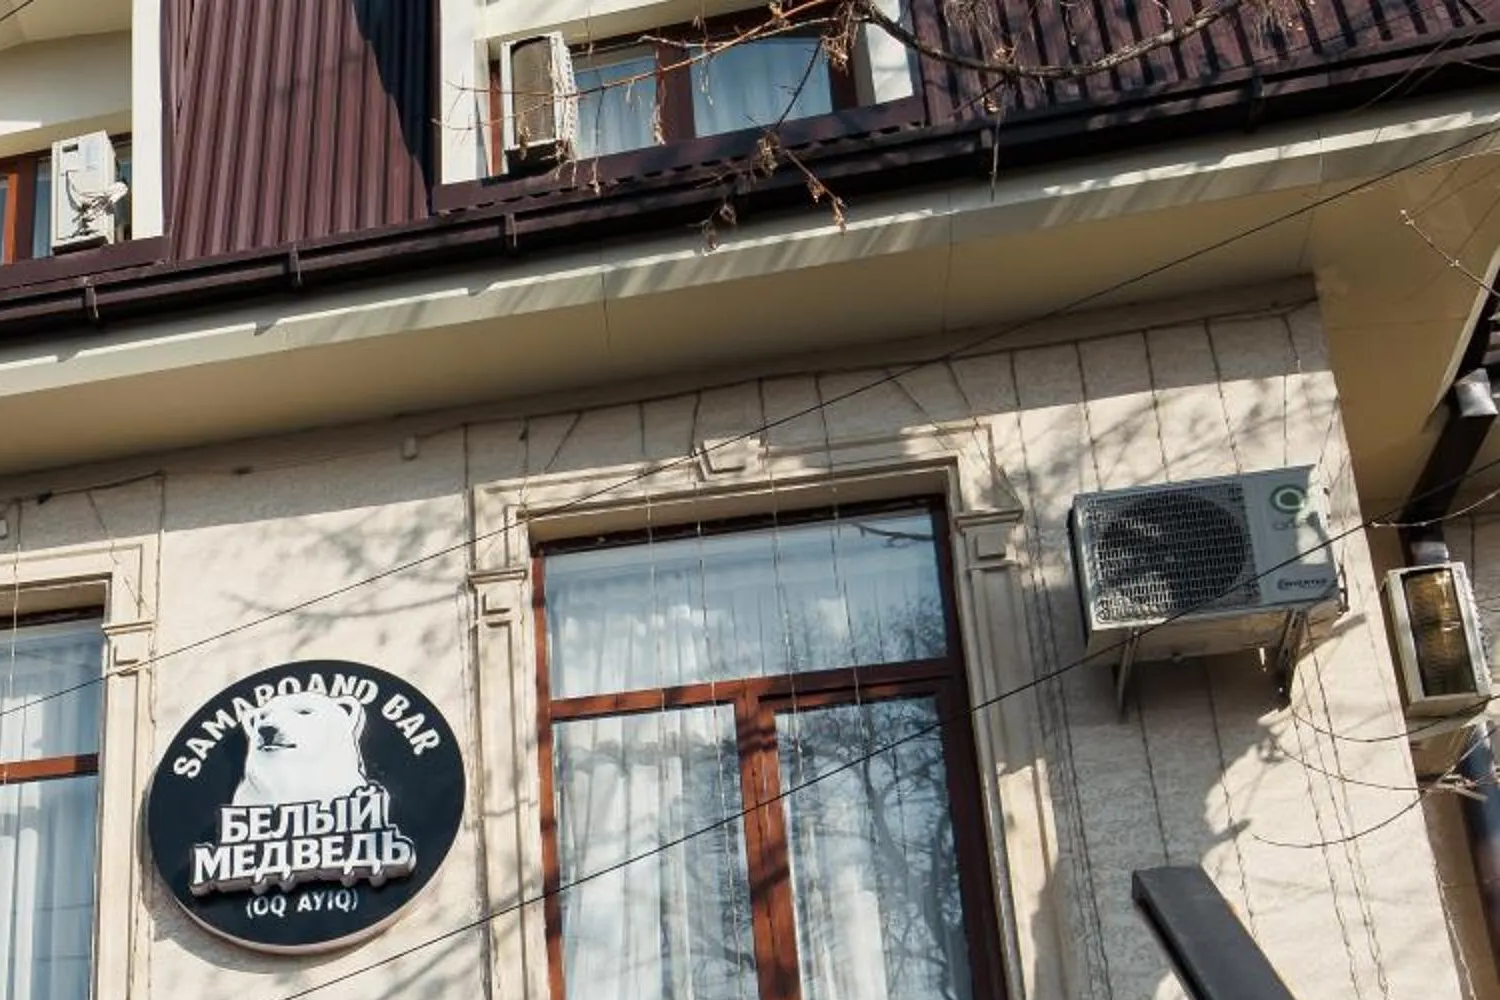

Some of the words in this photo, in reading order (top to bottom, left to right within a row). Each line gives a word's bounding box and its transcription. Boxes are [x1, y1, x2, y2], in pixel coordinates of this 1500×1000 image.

[381, 693, 441, 756] BAR
[220, 784, 382, 844] БЕЛЫЙ
[193, 831, 412, 886] МЕДВЕДЬ
[246, 894, 288, 919] (OQ
[297, 888, 359, 913] AYIQ)
